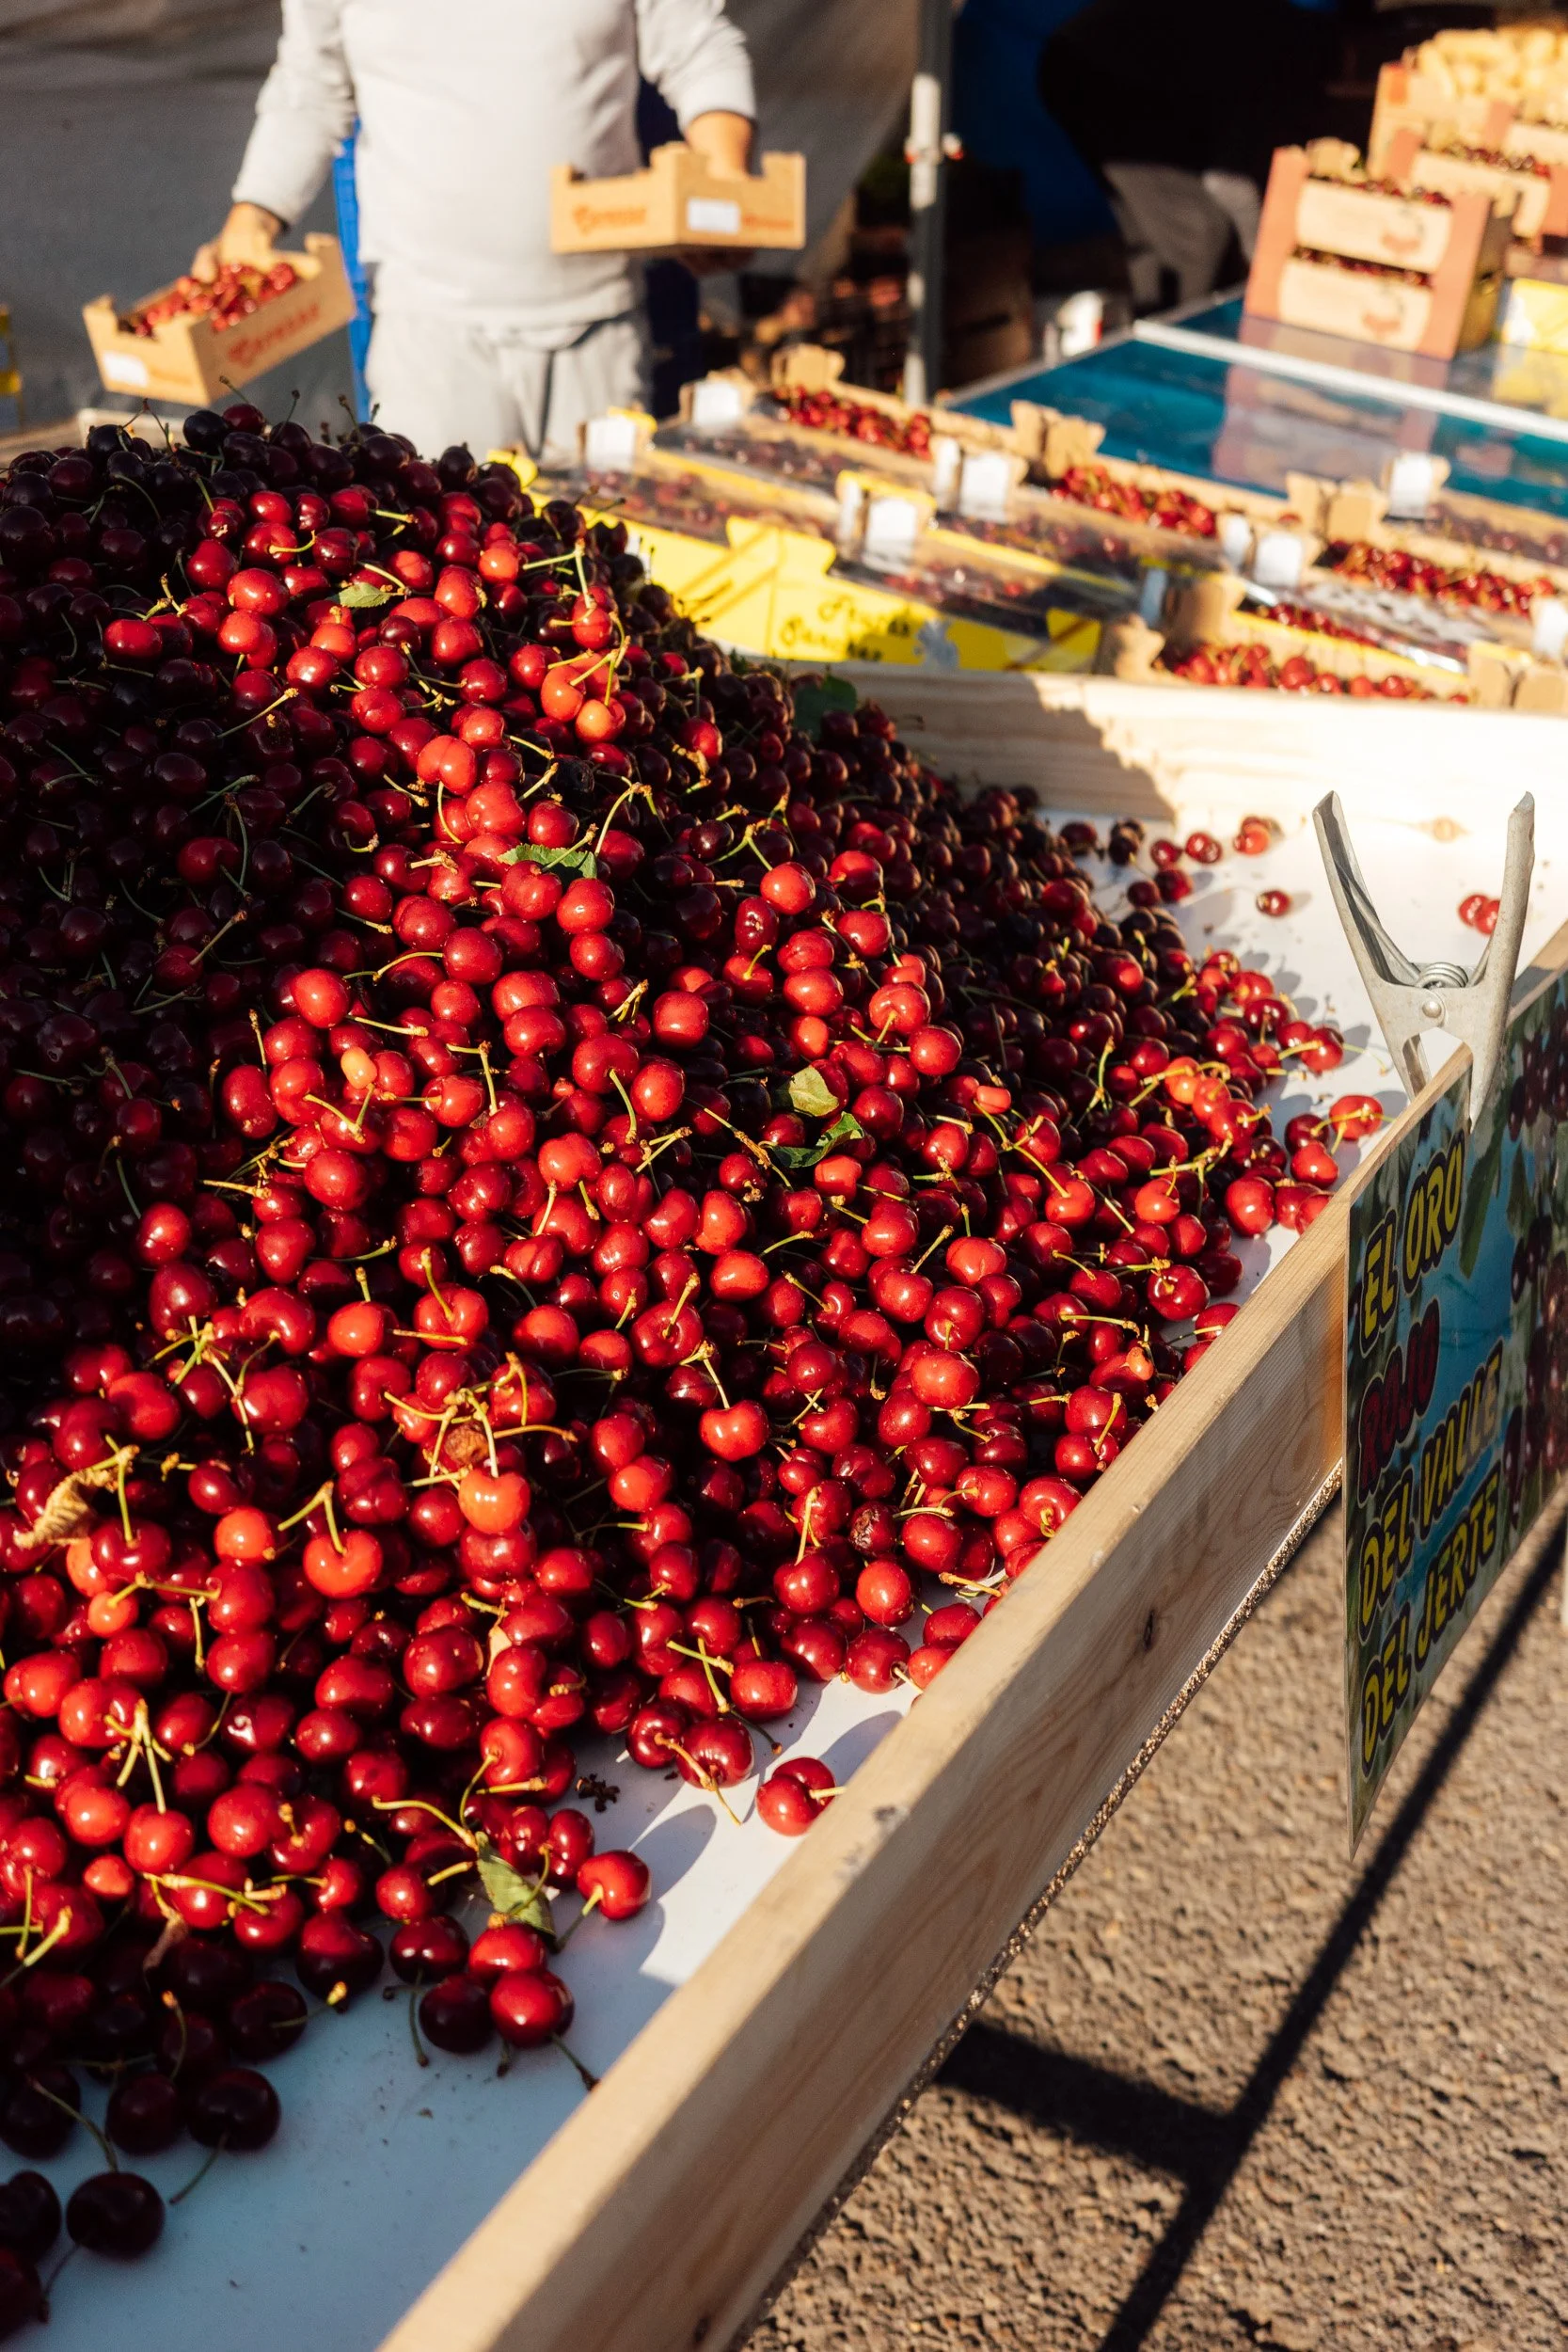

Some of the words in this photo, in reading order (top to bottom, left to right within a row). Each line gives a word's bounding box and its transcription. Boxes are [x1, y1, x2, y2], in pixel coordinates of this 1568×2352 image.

[1362, 1214, 1397, 1348] EL
[1403, 1134, 1465, 1289] ORO
[1360, 1301, 1439, 1502] ROJO
[1361, 1474, 1412, 1635] DEL
[1421, 1345, 1501, 1535] VALLE
[1363, 1608, 1411, 1774] DEL
[1414, 1465, 1500, 1668] JERTE
